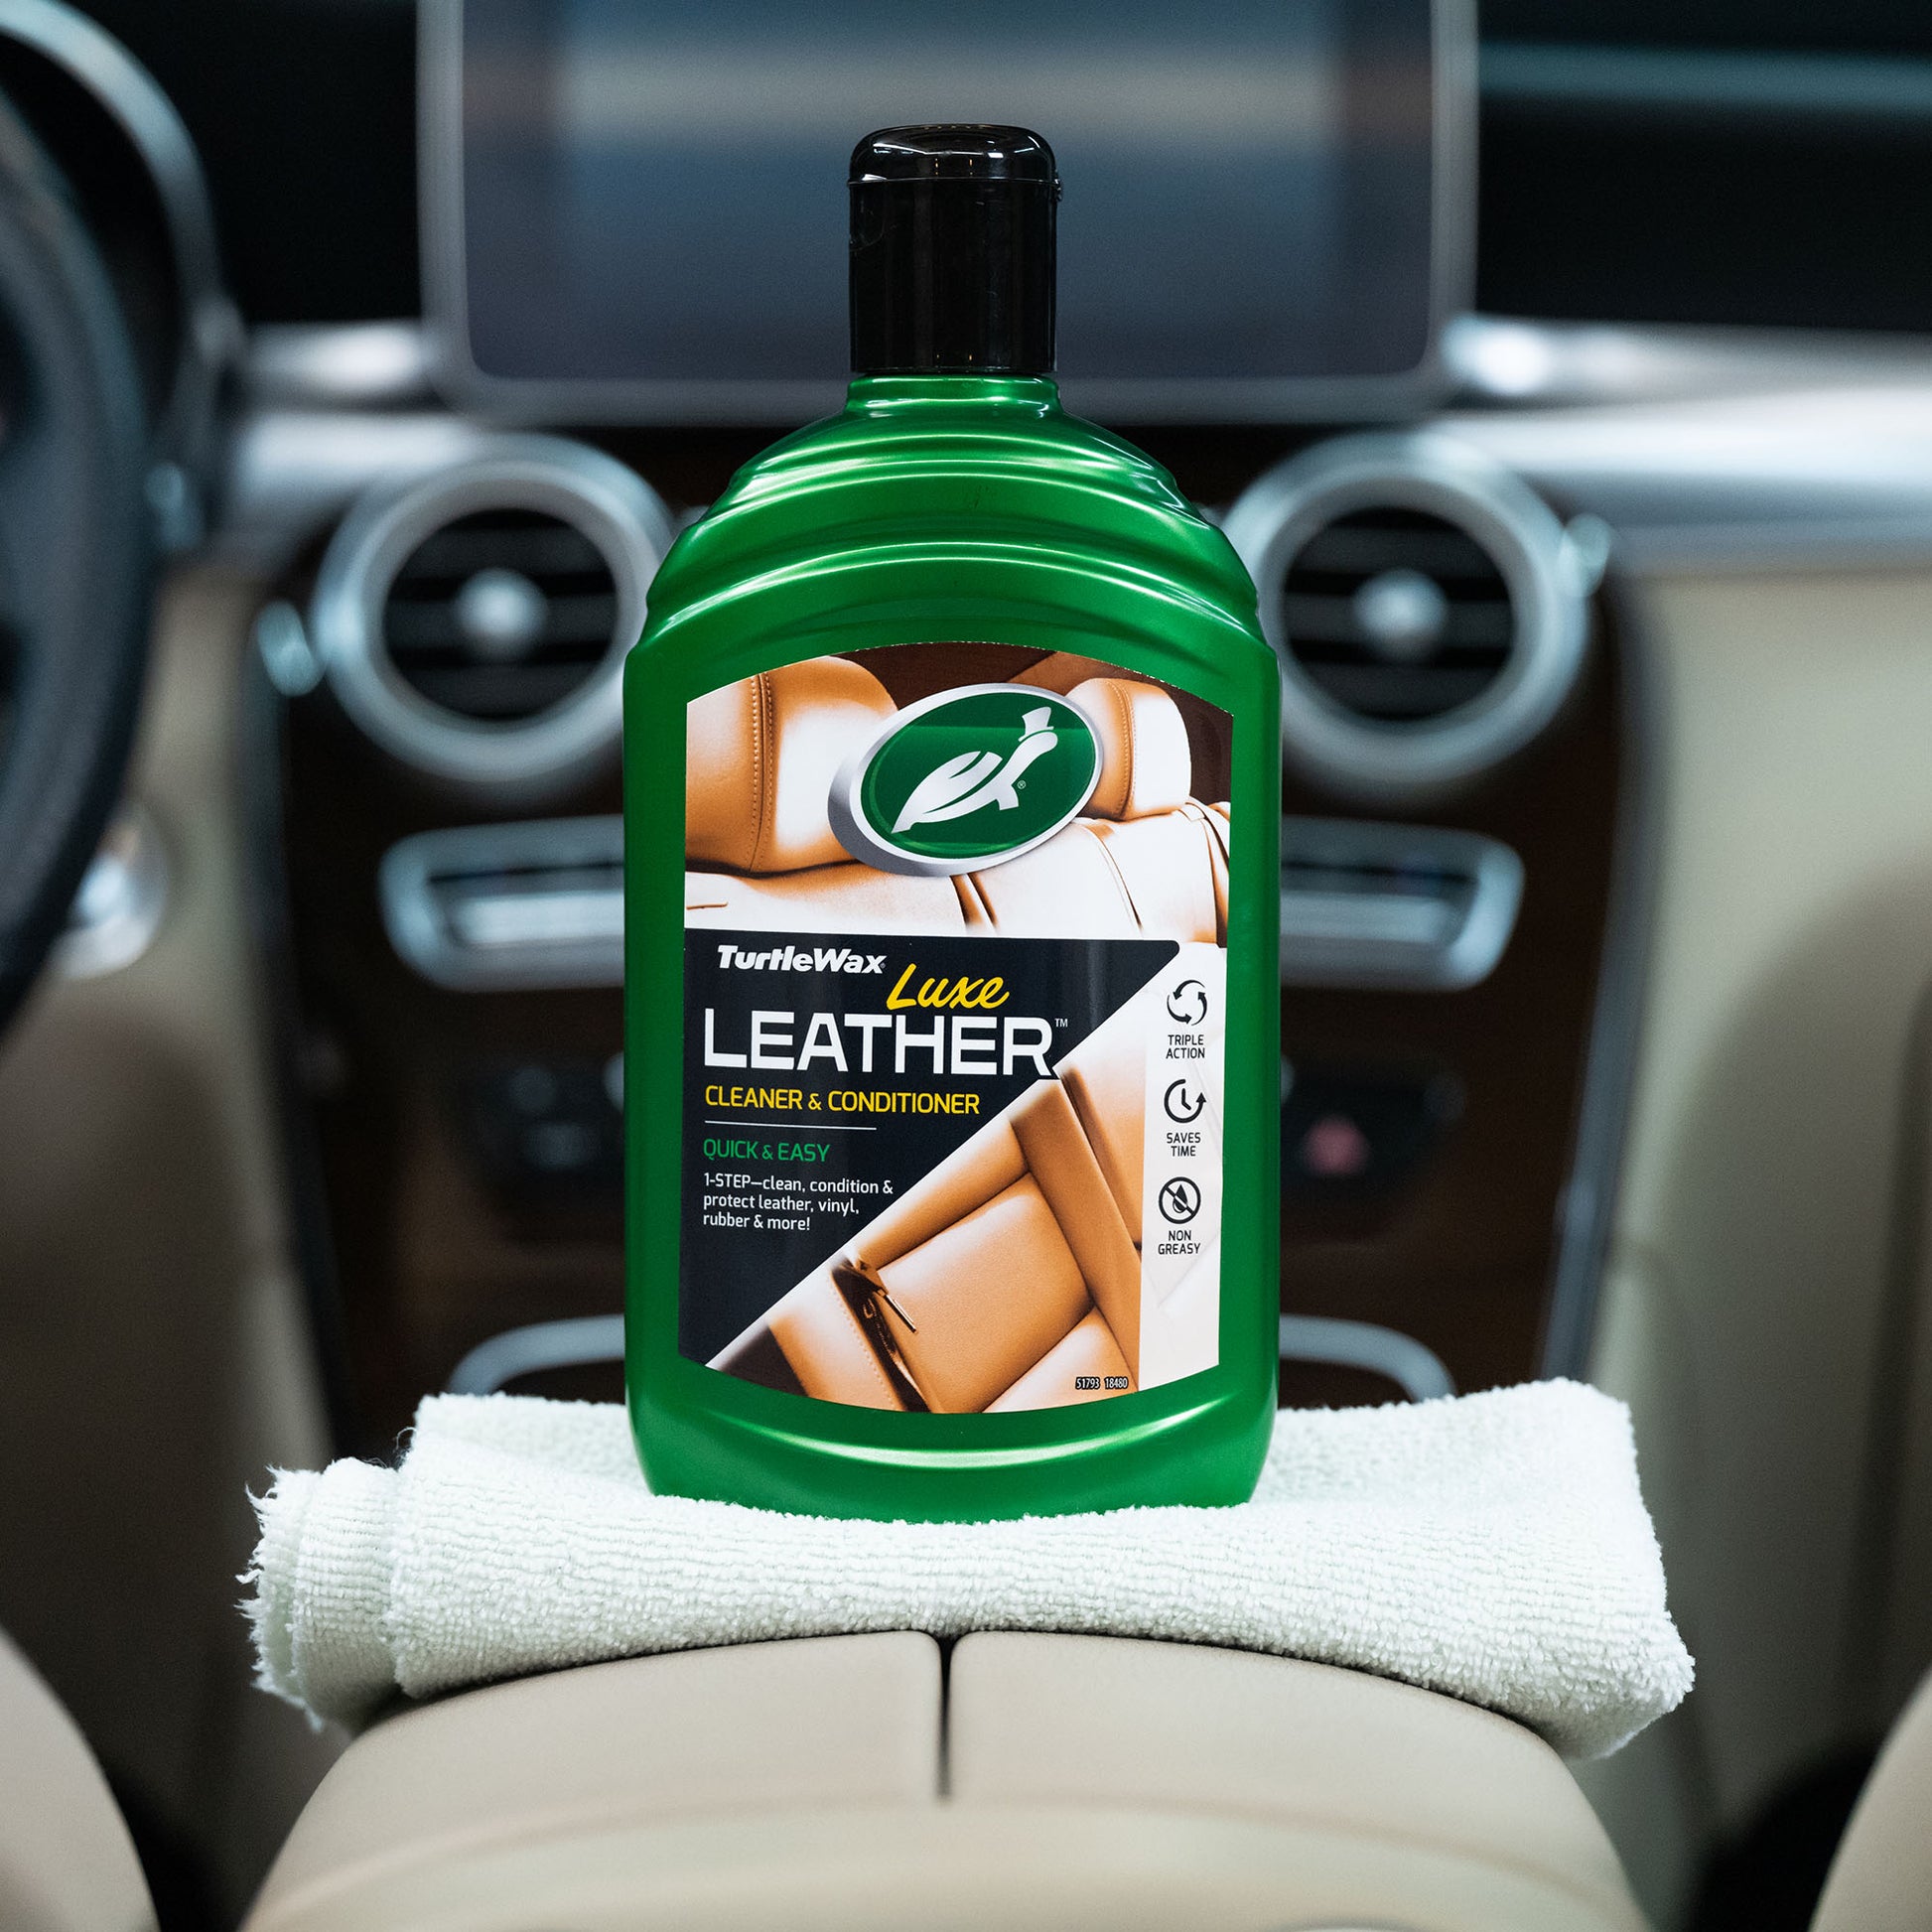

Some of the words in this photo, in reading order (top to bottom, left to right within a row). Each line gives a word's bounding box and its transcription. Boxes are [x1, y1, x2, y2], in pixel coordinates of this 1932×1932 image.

[886, 963, 1010, 1011] Luxe
[1168, 1035, 1204, 1046] TRIPLE
[1166, 1047, 1205, 1059] ACTION
[705, 1085, 803, 1110] CLEANER
[808, 1092, 822, 1110] &
[828, 1090, 981, 1115] CONDITIONER
[1166, 1132, 1201, 1144] SAVES
[703, 1138, 759, 1161] QUICK
[761, 1144, 774, 1161] &
[777, 1143, 830, 1163] EASY
[1171, 1145, 1196, 1157] TIME
[809, 1177, 880, 1194] condition
[882, 1179, 895, 1194] &
[703, 1194, 757, 1212] protect
[759, 1196, 814, 1213] leather,
[817, 1198, 859, 1217] vinyl,
[703, 1212, 750, 1228] rubber
[753, 1214, 764, 1229] &
[766, 1216, 810, 1231] more!
[1168, 1230, 1191, 1242] NON
[1158, 1243, 1201, 1255] GREASY
[1076, 1377, 1100, 1389] 51793
